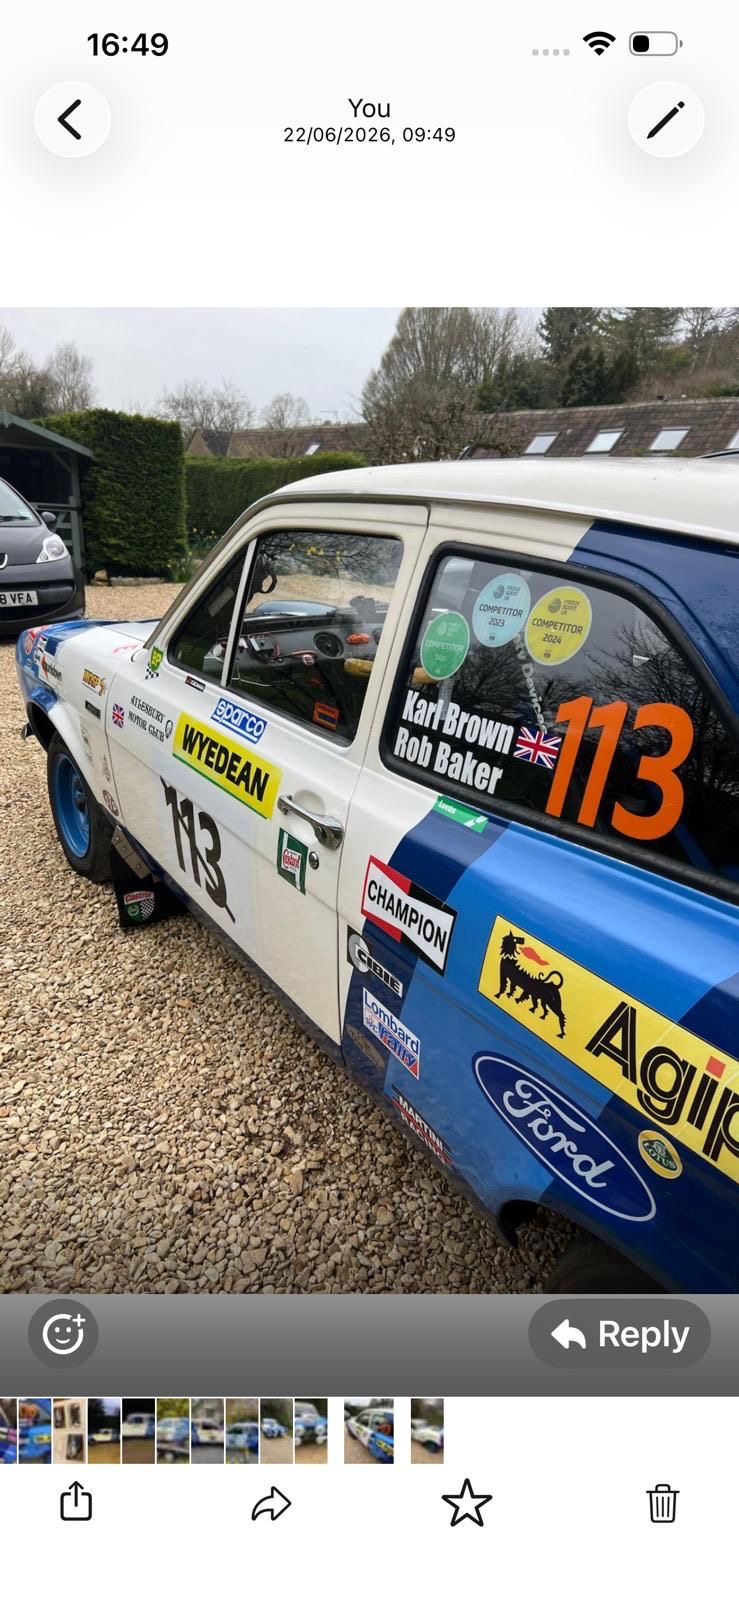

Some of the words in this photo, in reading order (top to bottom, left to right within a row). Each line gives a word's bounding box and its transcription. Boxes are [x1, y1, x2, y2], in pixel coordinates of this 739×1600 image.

[10, 593, 33, 603] VFA
[479, 603, 524, 618] COMPETITOR
[488, 617, 506, 628] 2023
[531, 617, 584, 634] COMPETITOR
[542, 633, 562, 645] 2024
[151, 651, 162, 667] BP
[425, 639, 465, 653] COMPETITOR
[128, 710, 147, 731] MOTOR
[148, 724, 165, 742] CLUB
[130, 695, 165, 724] AYLESBURY
[215, 700, 264, 740] sparco
[402, 690, 445, 727] Karl
[443, 703, 515, 755] Brown
[182, 723, 269, 803] WYEDEAN
[394, 727, 433, 767] Rob
[434, 745, 503, 795] Baker
[545, 696, 695, 841] 113
[438, 799, 457, 815] Lucas
[164, 782, 227, 909] 113
[367, 879, 449, 953] CHAMPION
[357, 948, 401, 994] CIBIE
[364, 991, 419, 1056] Lombard
[378, 1021, 416, 1069] rally
[585, 1000, 739, 1162] Agip
[398, 1095, 443, 1152] MARTINI
[502, 1078, 616, 1189] Ford
[643, 1142, 676, 1170] LOTUS
